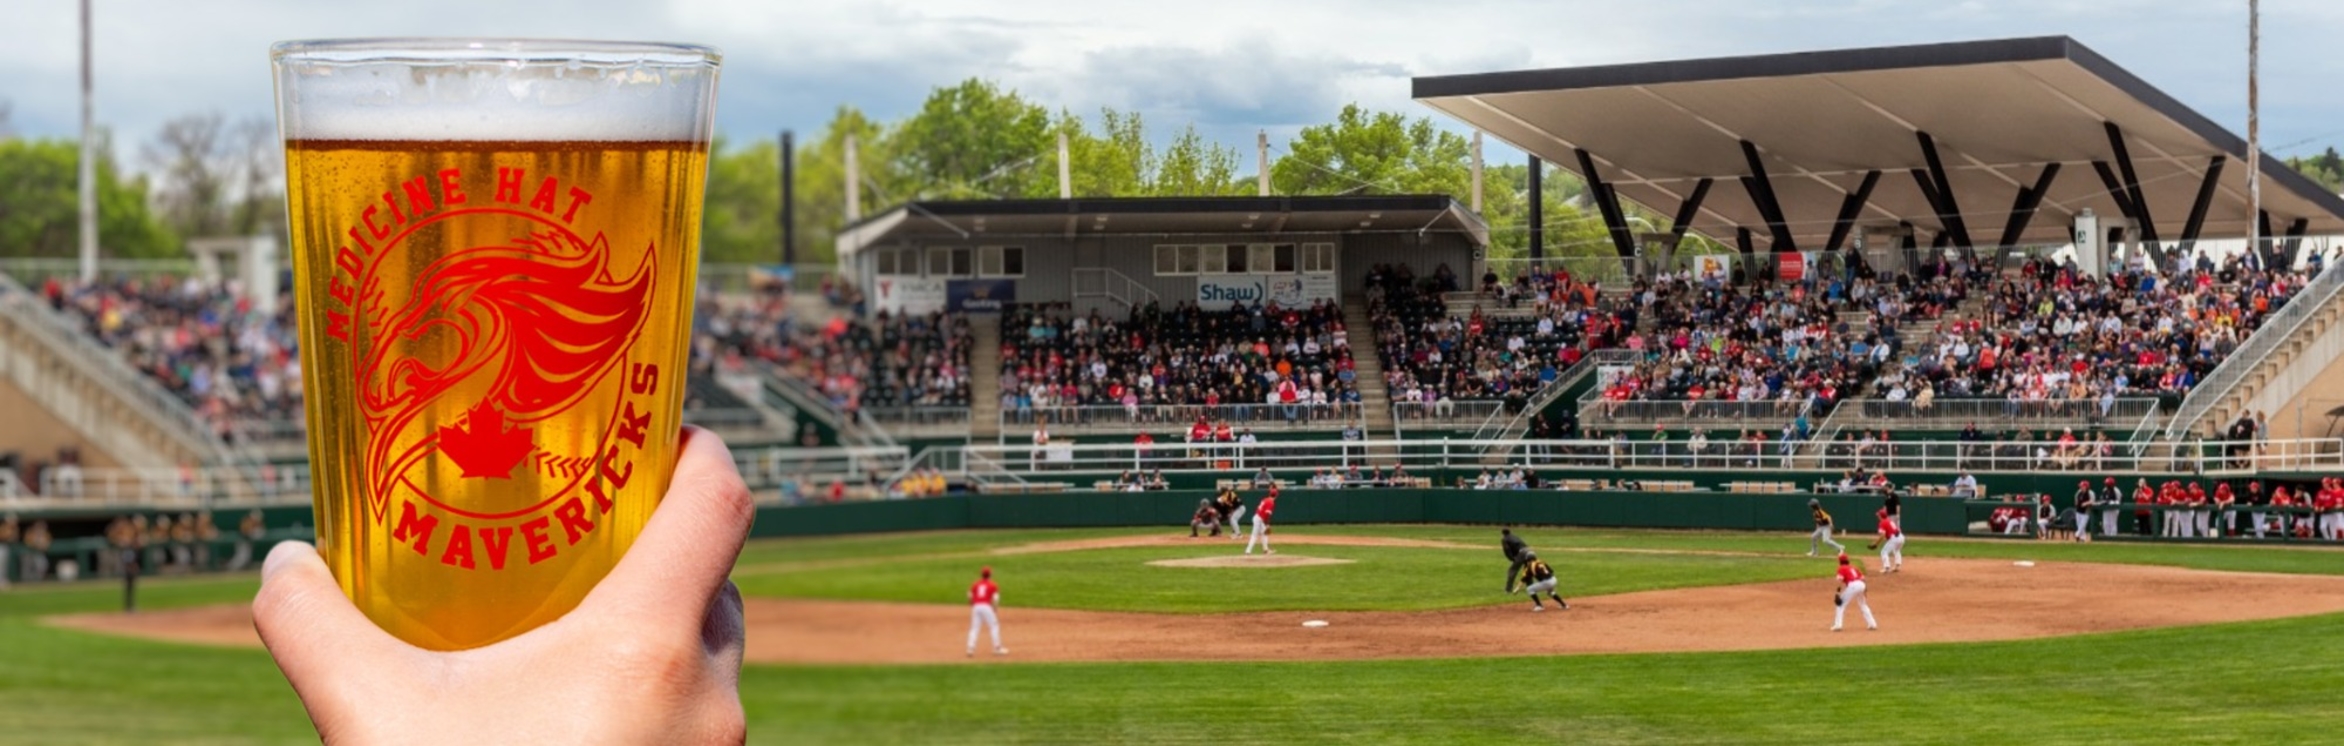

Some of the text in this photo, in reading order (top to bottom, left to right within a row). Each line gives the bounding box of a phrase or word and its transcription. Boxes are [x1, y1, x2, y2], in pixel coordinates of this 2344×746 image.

[326, 166, 592, 343] MEDICINE HAT
[1200, 284, 1254, 301] Shaw
[392, 362, 660, 571] MAVERICKS
